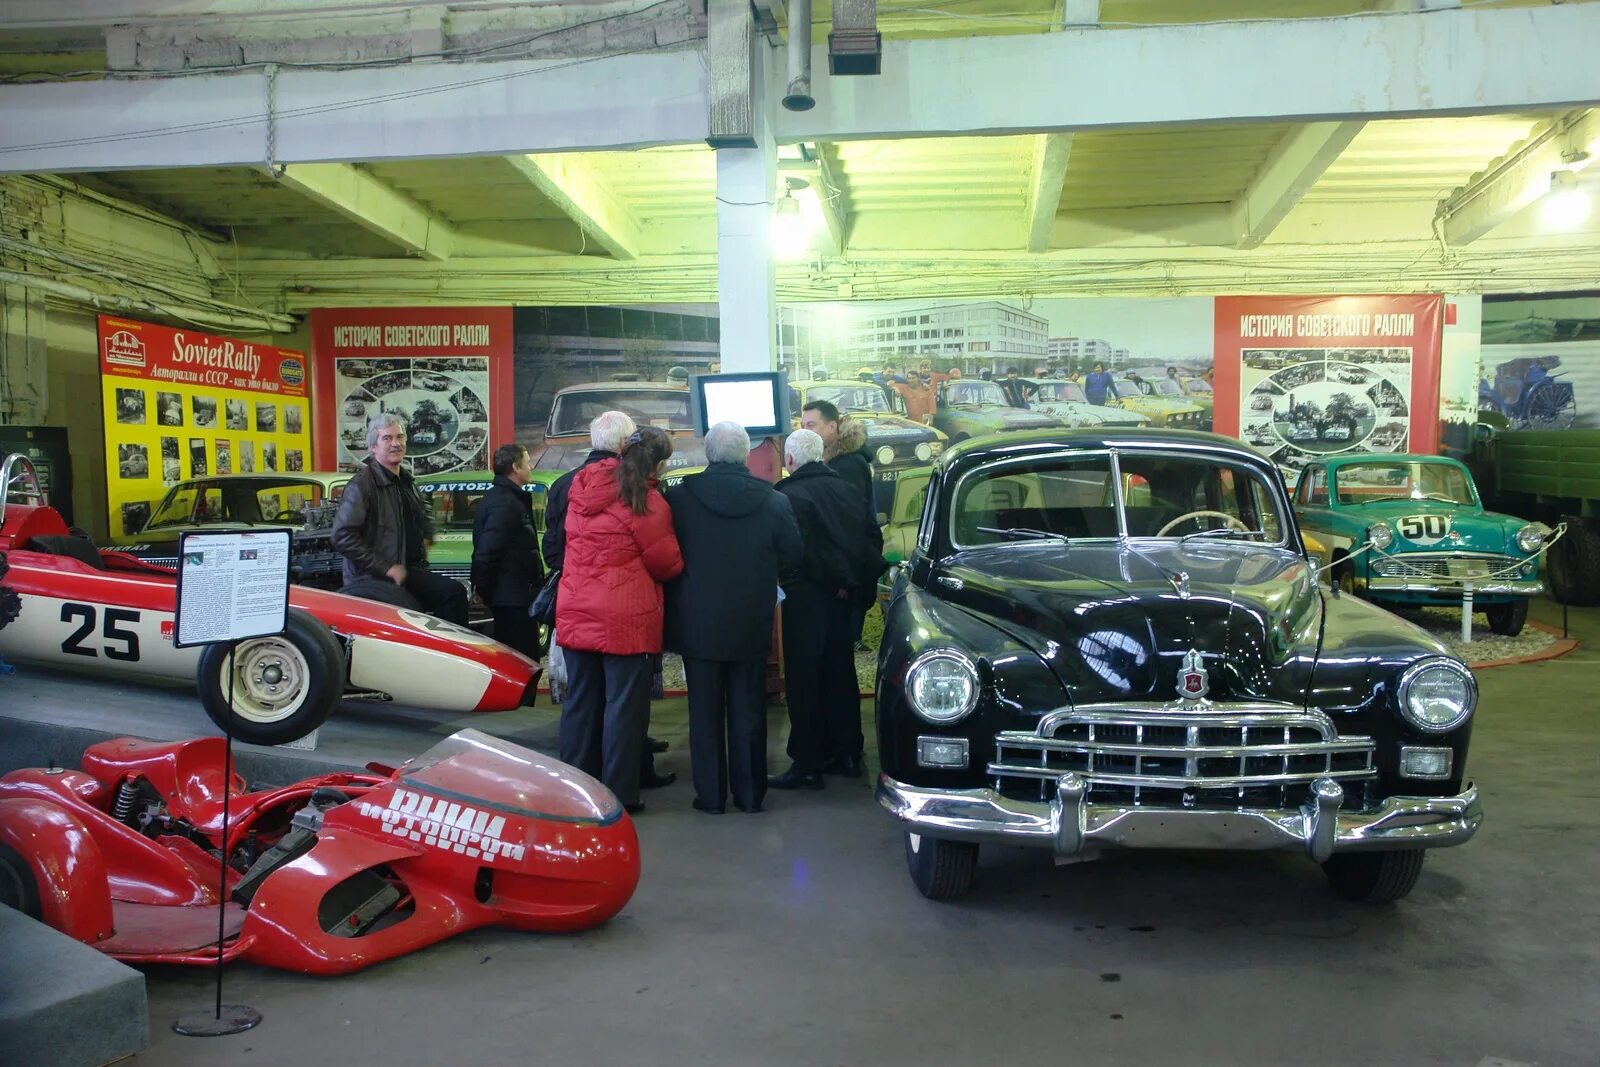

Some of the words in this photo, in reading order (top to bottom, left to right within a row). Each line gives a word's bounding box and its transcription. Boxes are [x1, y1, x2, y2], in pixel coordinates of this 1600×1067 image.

[334, 326, 381, 347] ИСТОРИЯ
[384, 325, 450, 347] СОВЕТСКОГО
[453, 325, 489, 346] РАЛЛИ
[1240, 314, 1293, 337] ИСТОРИЯ
[1297, 314, 1370, 337] СОВЕТСКОГО
[1374, 313, 1414, 336] РАЛЛИ
[172, 332, 261, 379] SovietRally
[150, 363, 197, 383] Авторалли
[205, 369, 229, 385] СССР
[234, 377, 246, 388] как
[261, 377, 279, 391] было
[1402, 515, 1447, 540] 50
[60, 602, 141, 662] 25
